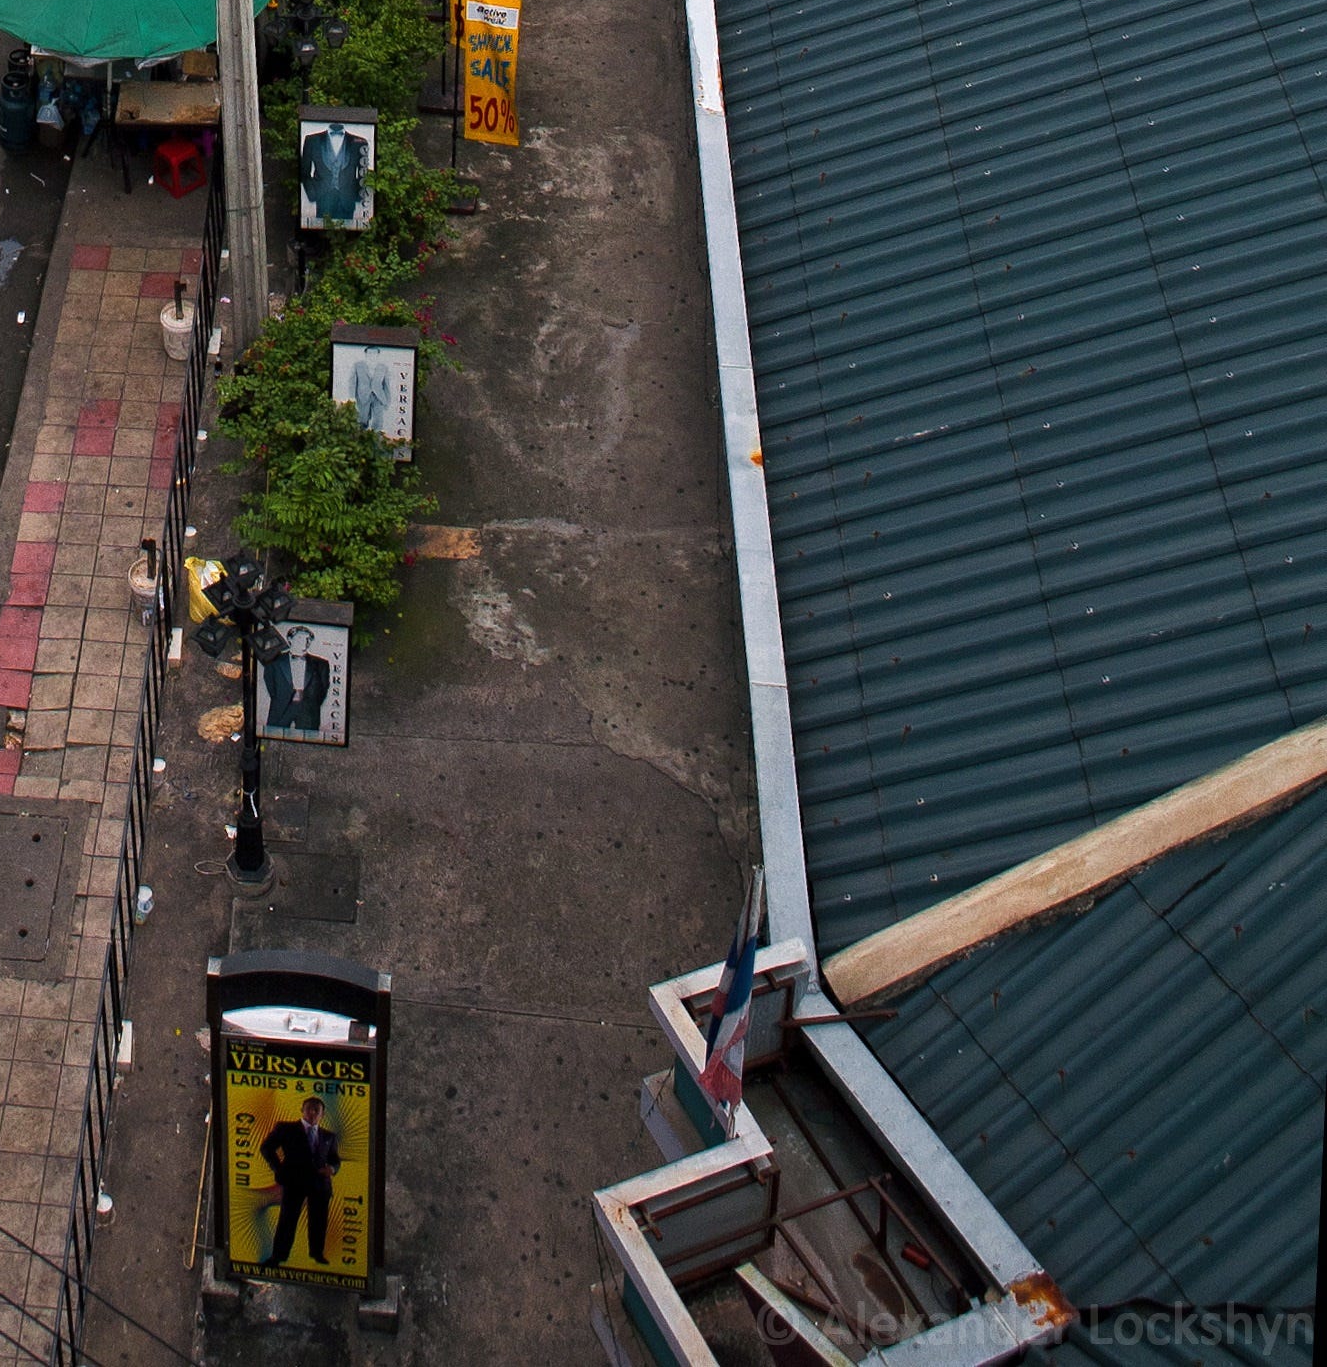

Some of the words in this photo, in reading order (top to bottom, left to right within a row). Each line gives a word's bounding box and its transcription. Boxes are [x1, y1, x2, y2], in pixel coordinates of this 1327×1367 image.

[476, 5, 507, 17] active
[470, 58, 511, 92] SALE
[470, 94, 514, 134] 50%
[397, 371, 409, 458] VERSACS
[330, 651, 342, 743] VERSACES
[230, 1051, 365, 1080] VERSACES
[231, 1073, 288, 1090] LADIES
[296, 1080, 306, 1093] &
[313, 1080, 367, 1098] GENTS
[235, 1111, 256, 1188] Custom
[342, 1195, 363, 1266] Tailors
[232, 1262, 367, 1291] www.newversaces.com
